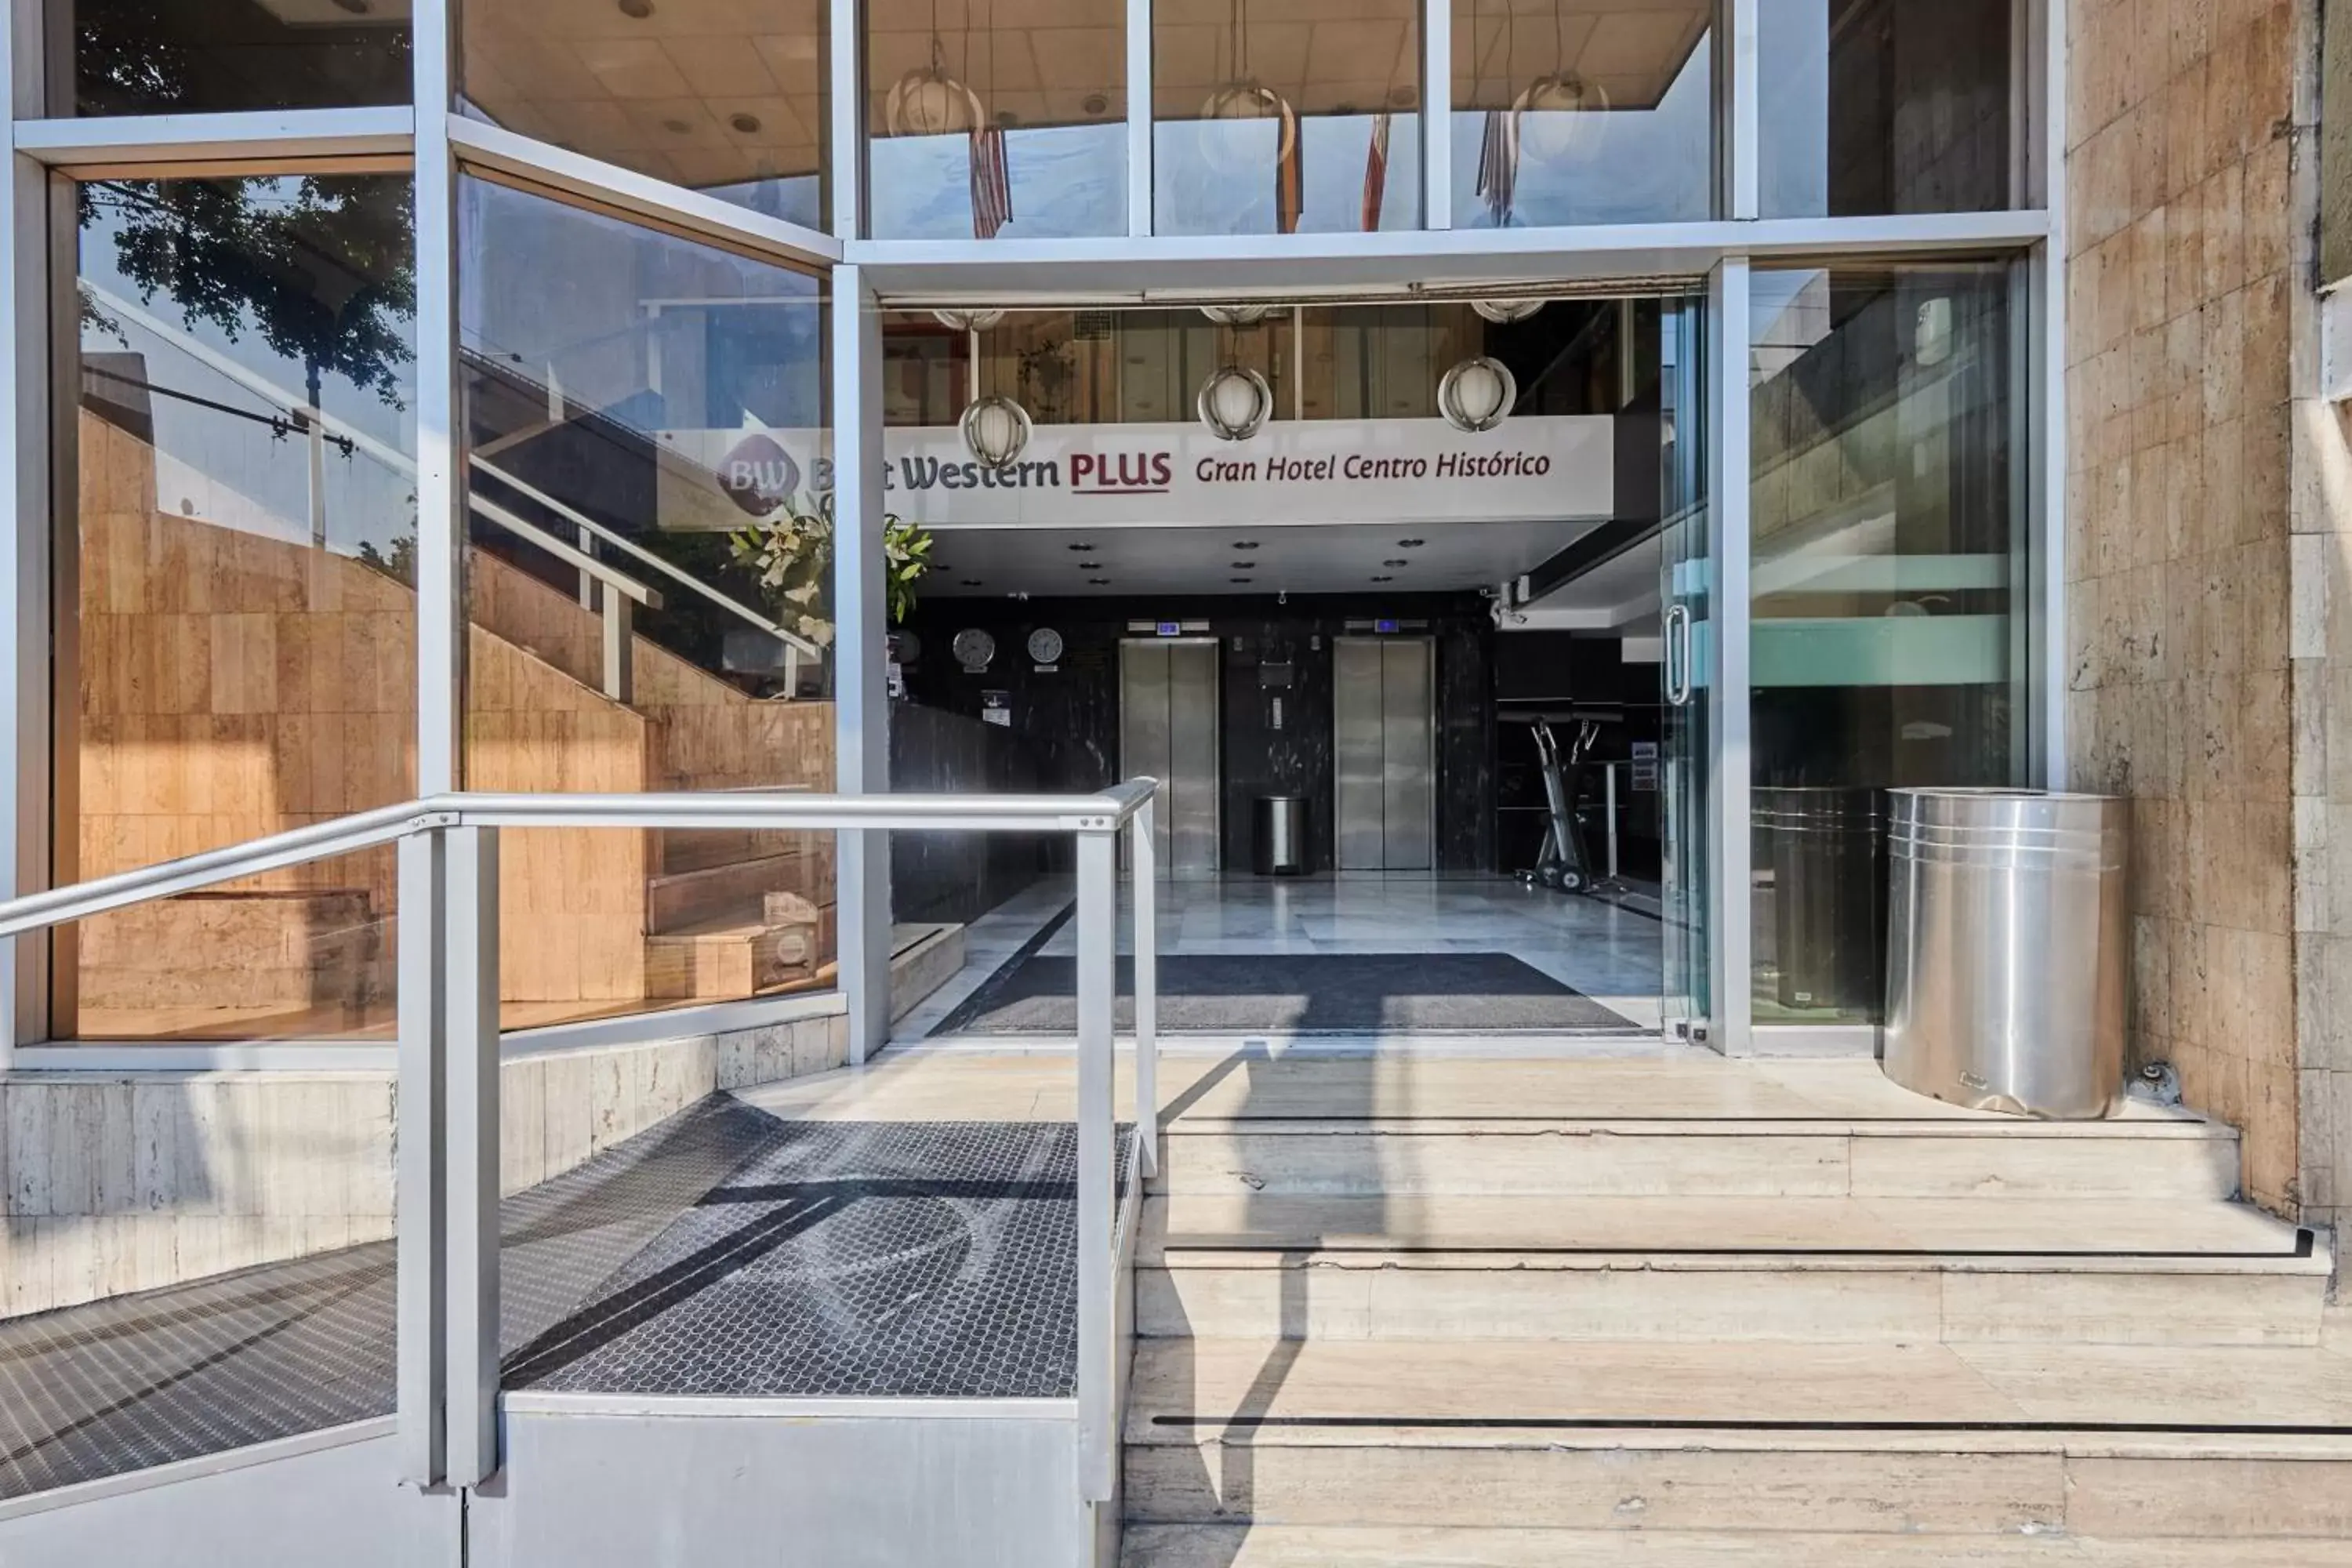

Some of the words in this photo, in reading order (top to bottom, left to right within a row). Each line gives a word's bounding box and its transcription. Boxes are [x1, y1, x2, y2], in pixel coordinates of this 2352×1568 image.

[729, 459, 789, 492] BW
[808, 457, 895, 492] Bt
[901, 456, 1061, 490] Western
[1069, 452, 1172, 487] PLUS
[1196, 457, 1257, 482] Gran
[1265, 454, 1336, 481] Hotel
[1343, 455, 1428, 479] Centro
[1435, 451, 1551, 478] Histórico
